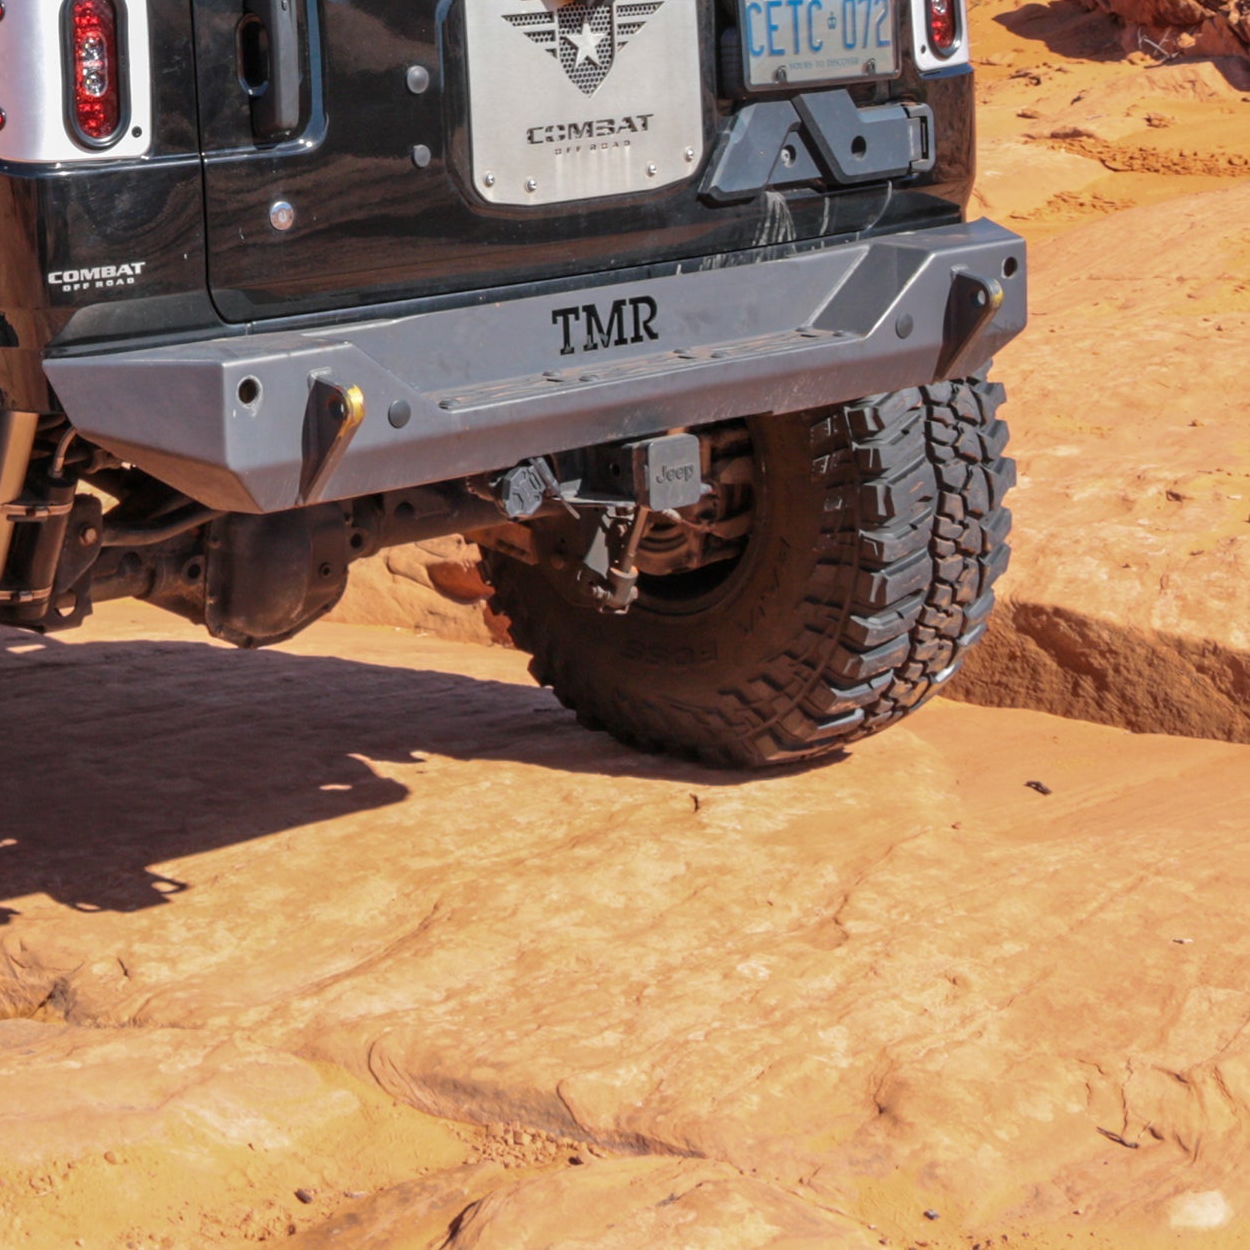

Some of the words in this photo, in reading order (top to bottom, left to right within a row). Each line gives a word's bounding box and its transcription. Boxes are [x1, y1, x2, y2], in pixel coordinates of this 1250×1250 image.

[526, 113, 655, 145] COMBAT
[554, 146, 581, 155] OFF
[590, 139, 631, 151] ROAD
[48, 261, 146, 284] COMBAT
[62, 282, 90, 292] OFF
[95, 277, 135, 288] ROAD
[551, 295, 659, 356] TMR
[655, 464, 694, 484] Jeep
